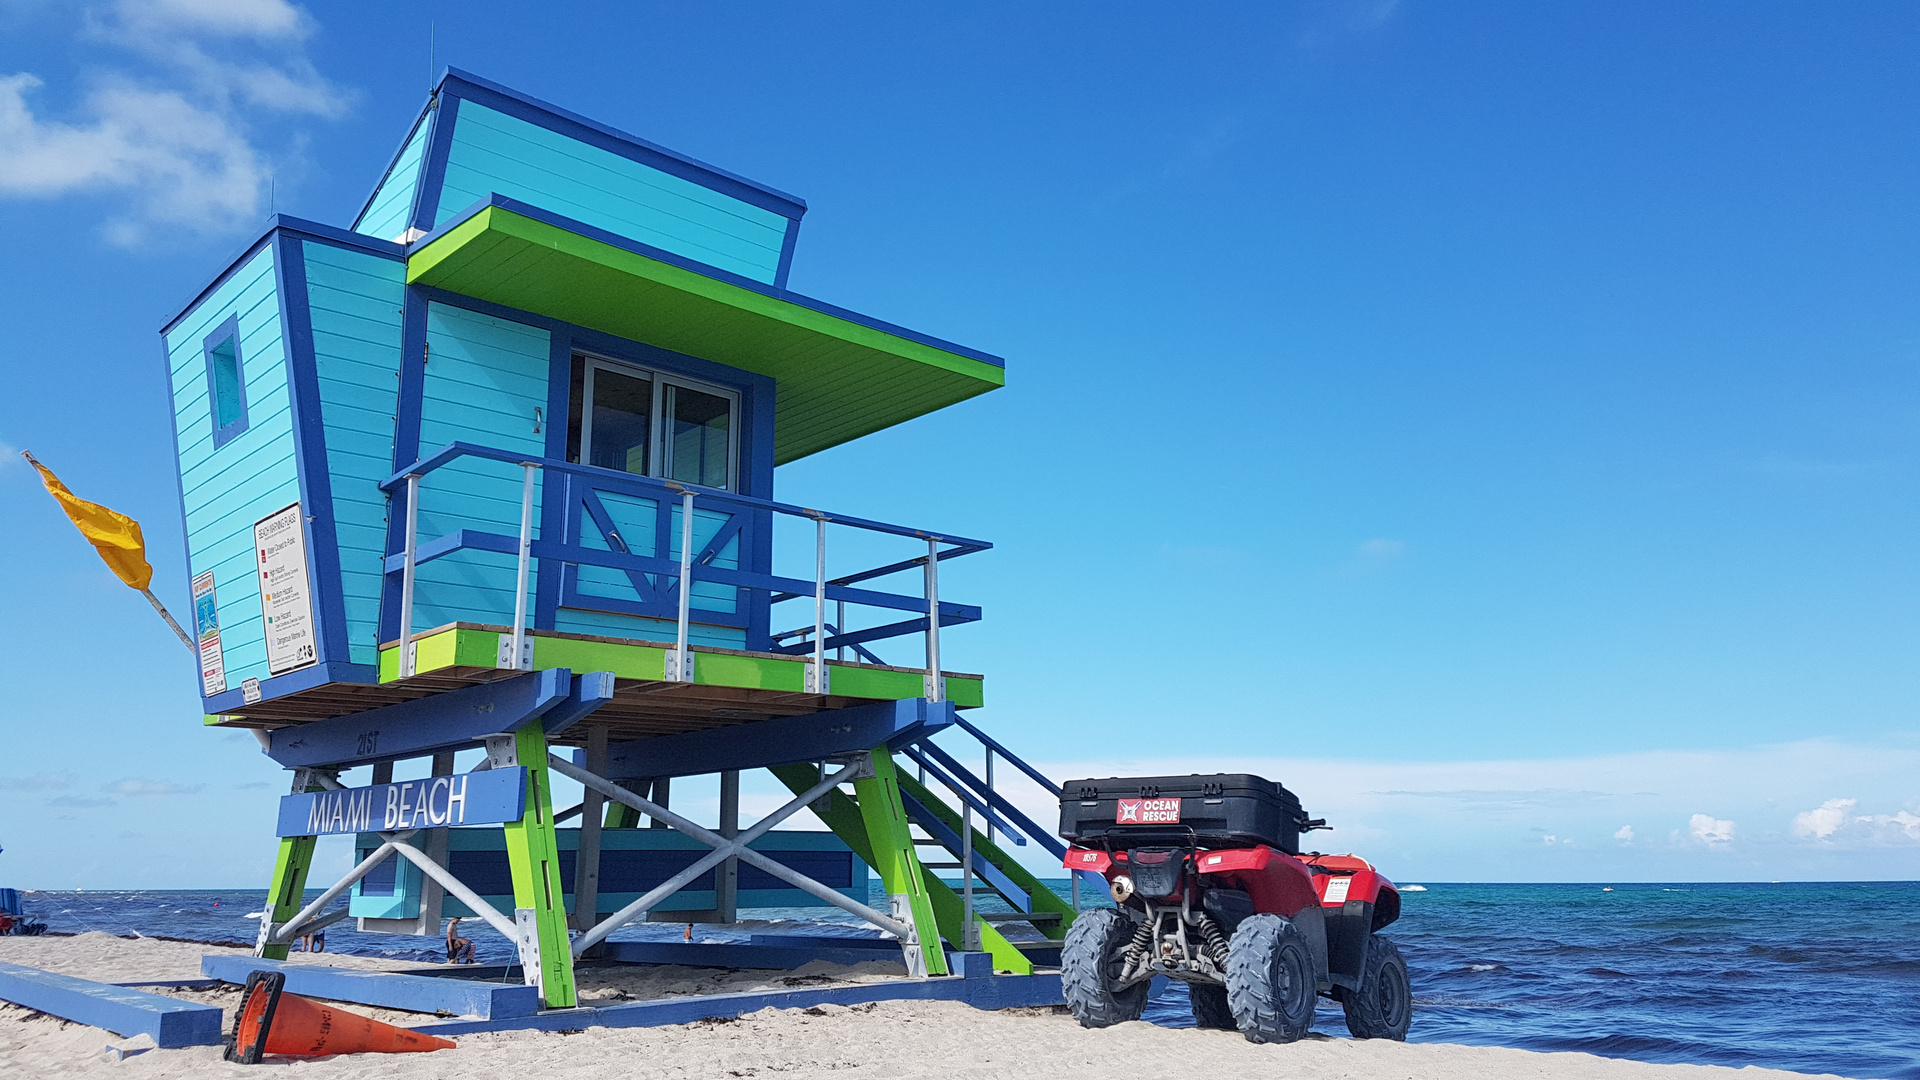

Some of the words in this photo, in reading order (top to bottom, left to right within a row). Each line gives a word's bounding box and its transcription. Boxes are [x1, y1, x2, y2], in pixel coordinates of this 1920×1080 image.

[259, 526, 269, 539] BEACH
[285, 513, 296, 526] FLAGS
[356, 731, 380, 756] 21ST
[306, 790, 372, 834] MIAMI
[384, 775, 468, 829] BEACH
[1142, 811, 1178, 822] RESCUE
[1144, 800, 1179, 812] OCEAN
